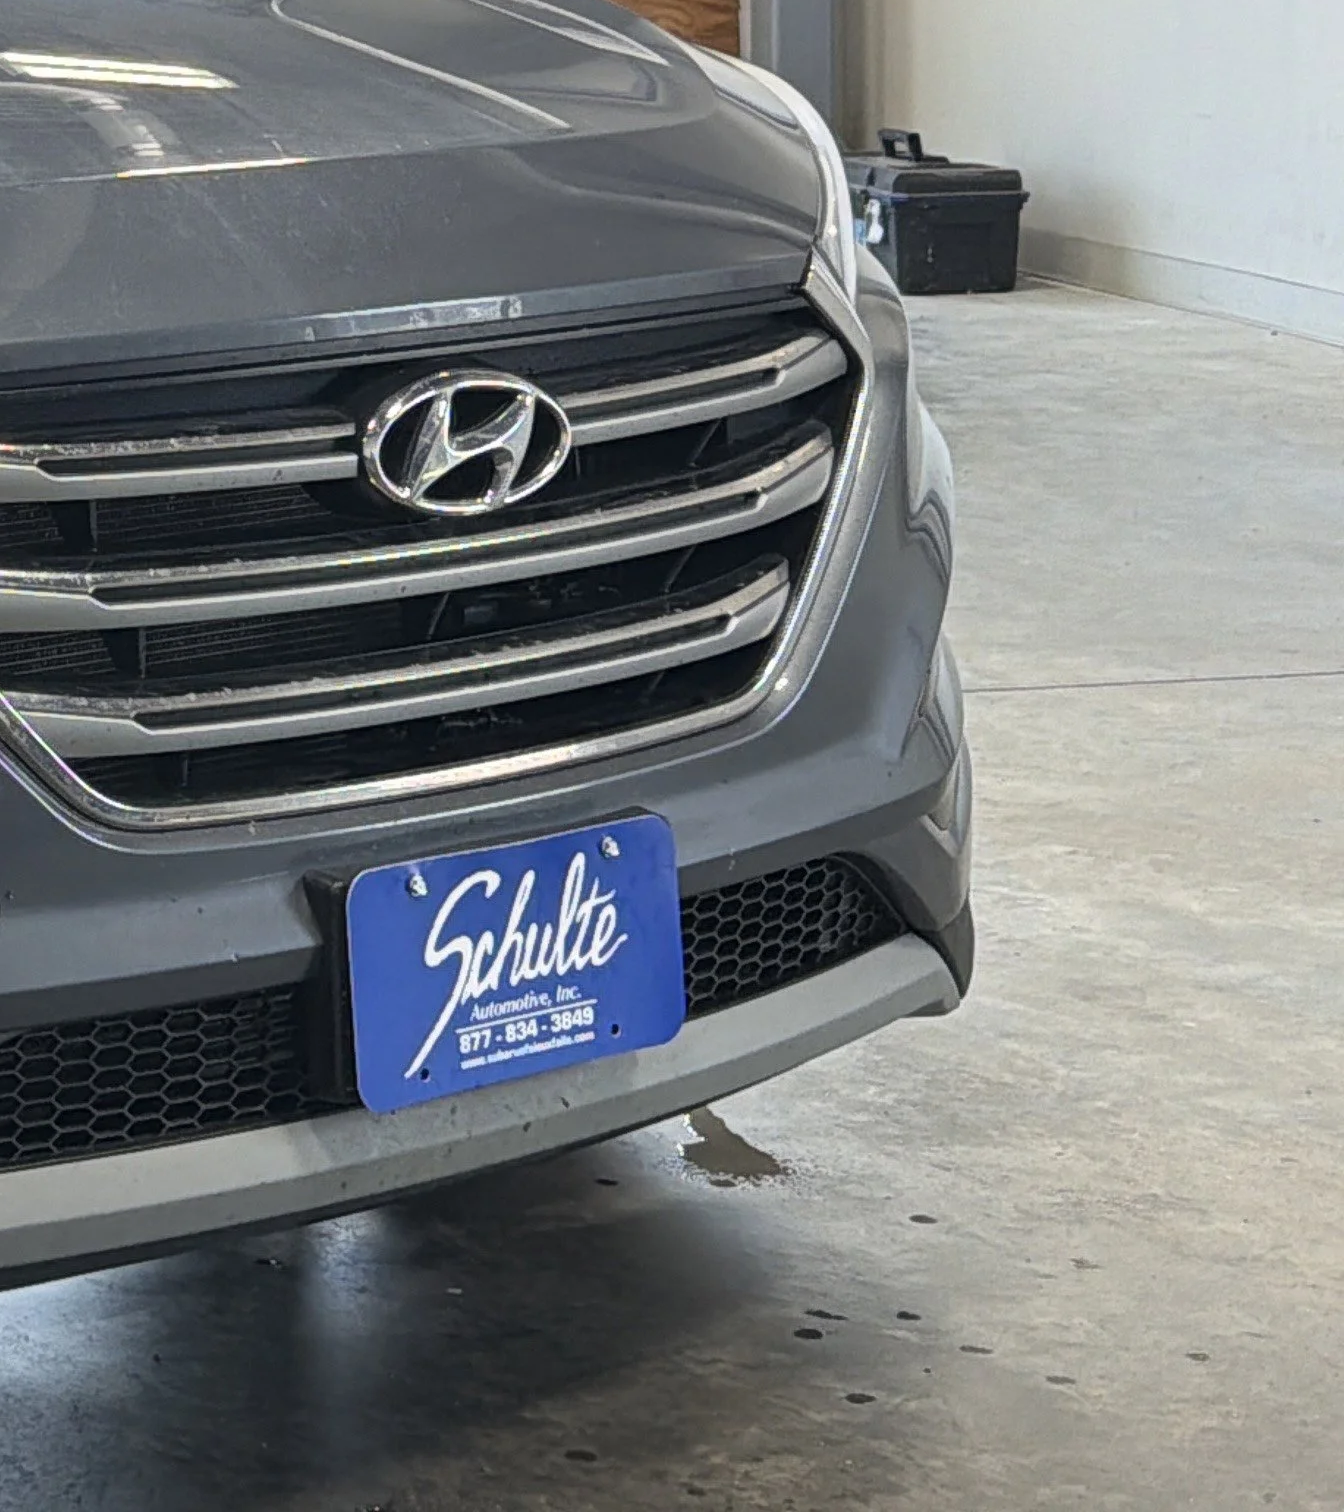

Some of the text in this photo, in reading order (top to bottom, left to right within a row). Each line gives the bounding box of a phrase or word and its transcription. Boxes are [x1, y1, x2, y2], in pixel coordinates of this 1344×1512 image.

[404, 851, 629, 1080] Schulte
[469, 984, 582, 1022] Automotive, Inc.
[459, 1028, 492, 1054] 877
[505, 1018, 539, 1043] 834
